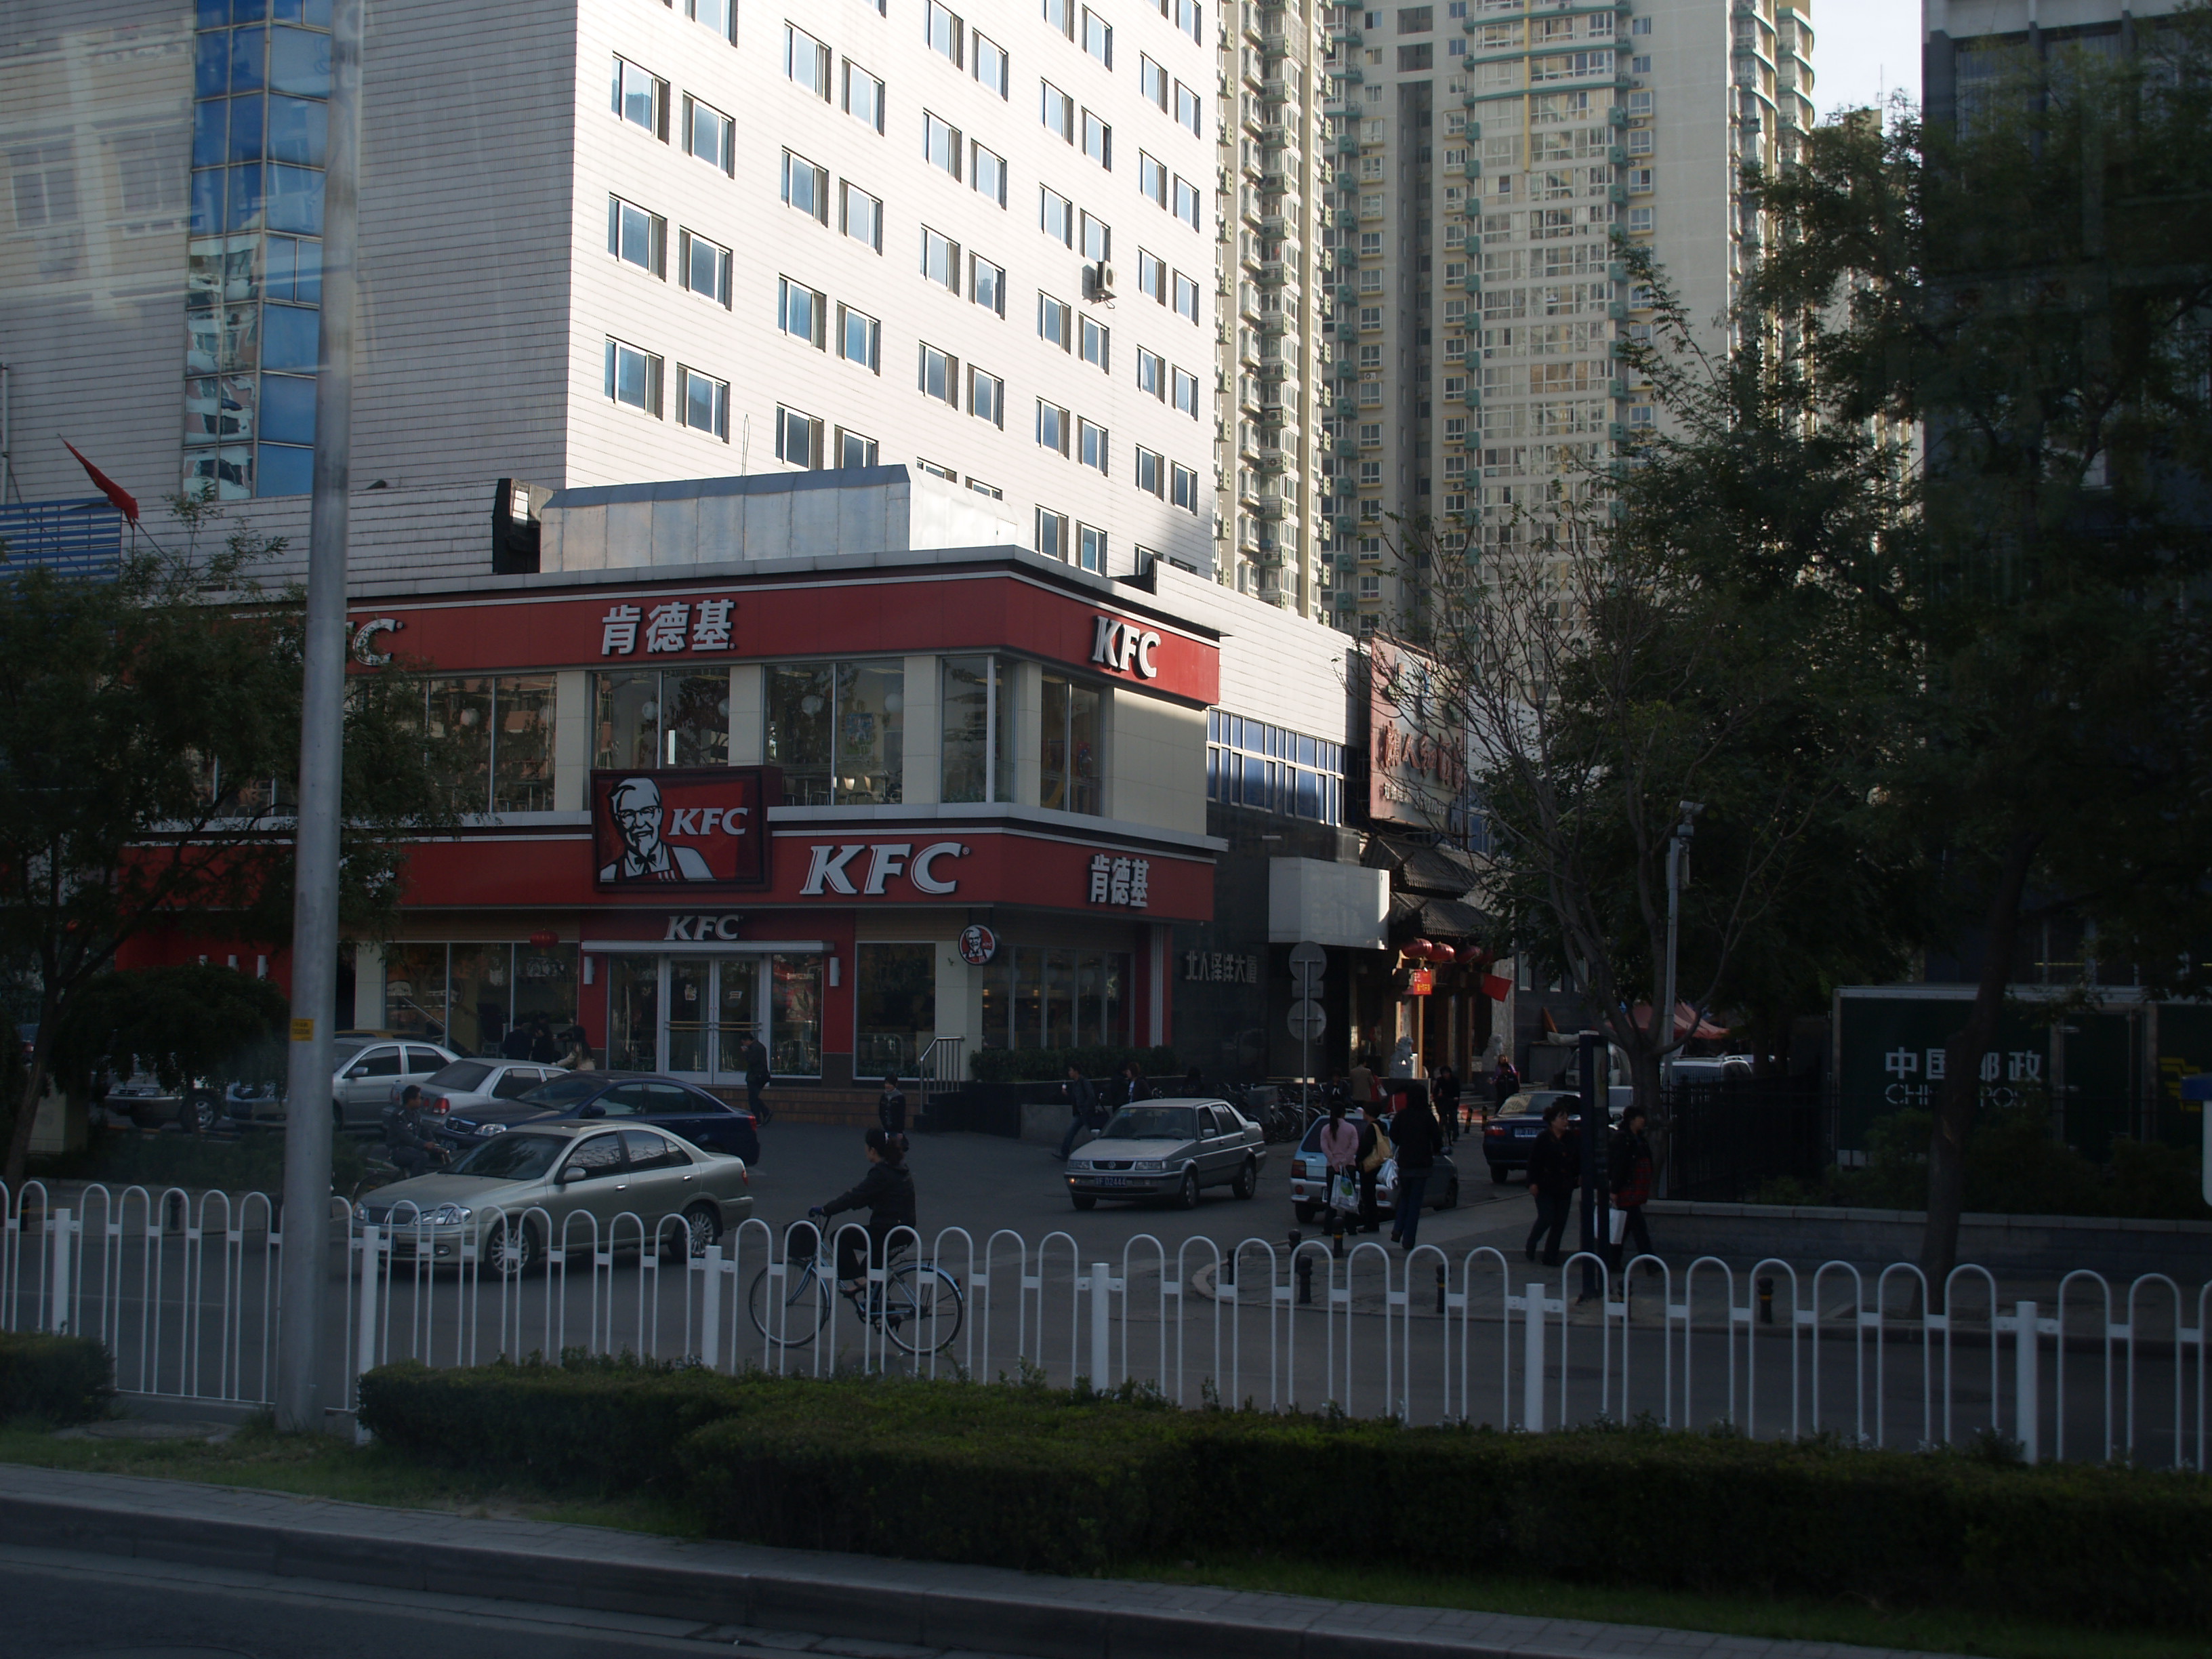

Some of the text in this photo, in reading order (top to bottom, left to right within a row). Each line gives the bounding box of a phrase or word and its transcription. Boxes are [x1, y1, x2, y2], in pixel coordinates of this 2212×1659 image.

[601, 598, 735, 655] 肯德基
[1091, 615, 1162, 679] KFC
[668, 806, 749, 836] KFC
[800, 841, 962, 895] KFC
[1090, 853, 1149, 907] 肯德基
[663, 914, 739, 940] KFC
